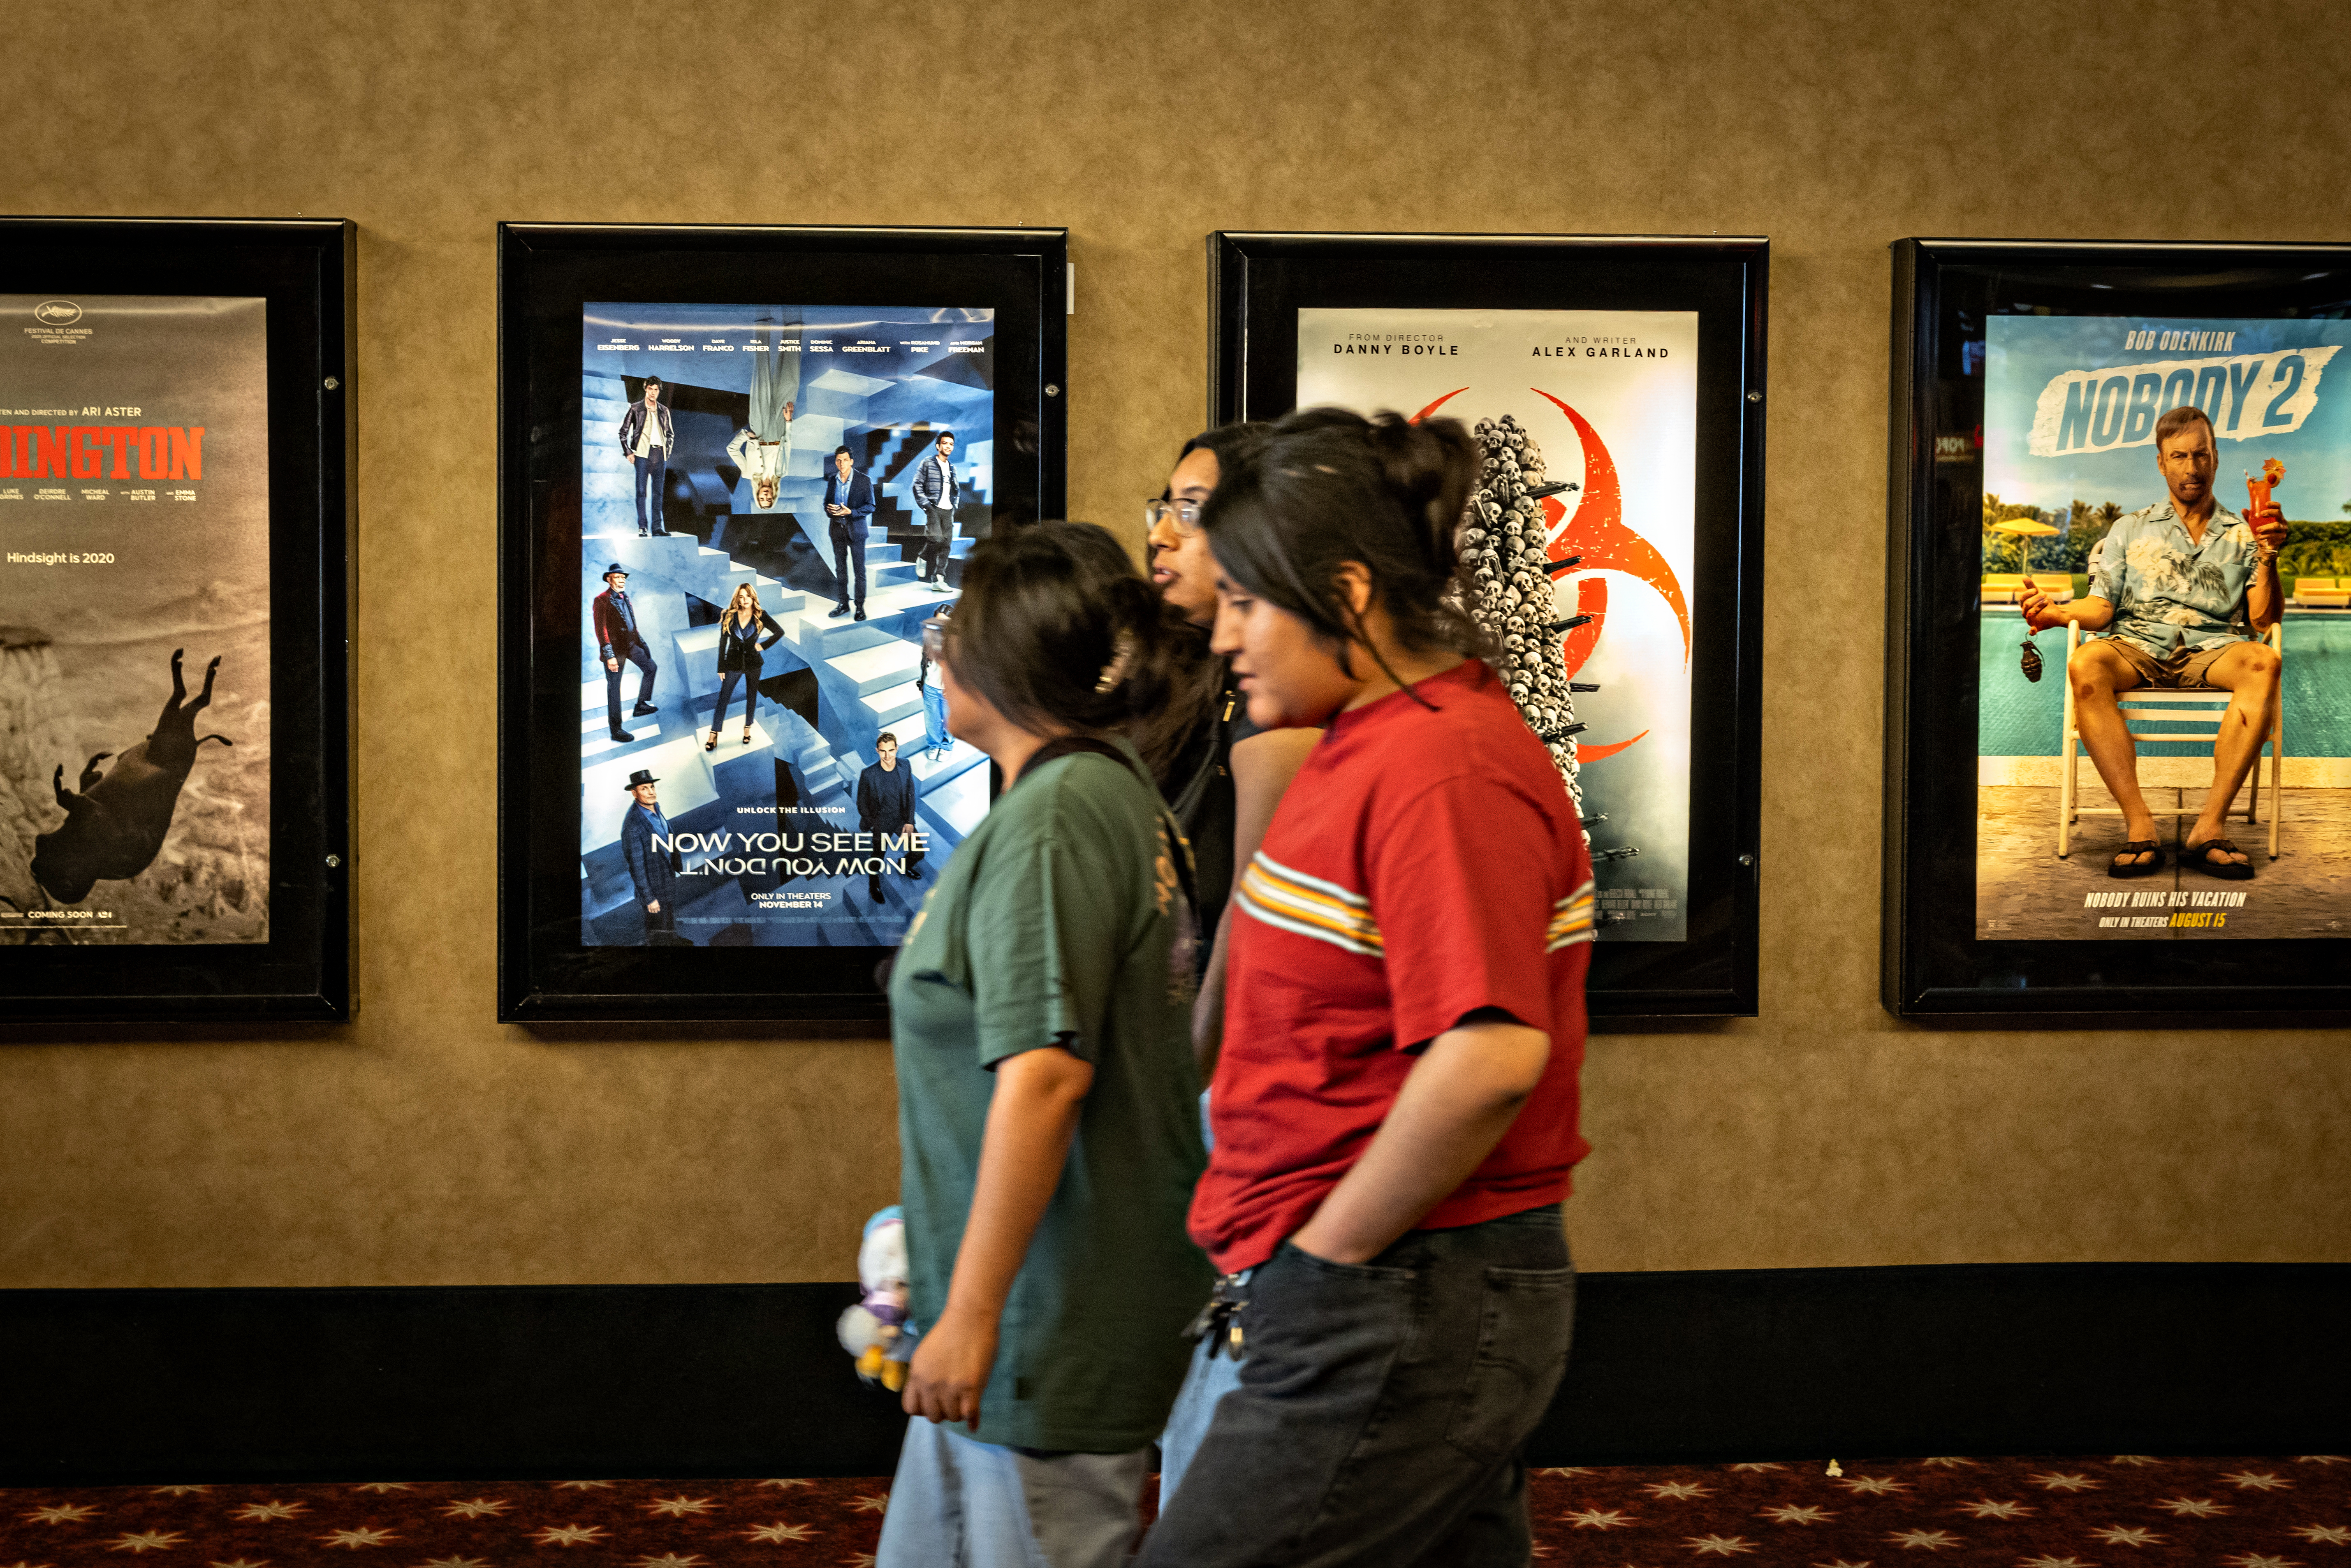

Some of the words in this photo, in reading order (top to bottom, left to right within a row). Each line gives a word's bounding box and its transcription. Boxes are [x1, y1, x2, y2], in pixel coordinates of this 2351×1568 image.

[2125, 330, 2155, 350] BOB
[2159, 331, 2236, 351] ODENKIRK
[1334, 345, 1392, 354] DANNY
[1402, 345, 1459, 355] BOYLE
[1532, 347, 1576, 357] ALEX
[1587, 347, 1669, 358] GARLAND
[2057, 360, 2263, 451] NOBODY
[2263, 355, 2305, 427] 2
[82, 407, 101, 416] ARI
[105, 407, 141, 417] ASTER
[7, 553, 66, 565] Hindsight
[69, 553, 80, 563] is
[82, 553, 115, 563] 2020
[651, 833, 732, 852] NOW
[738, 833, 804, 852] YOU
[811, 833, 872, 852] SEE
[881, 832, 930, 852] ME
[772, 858, 830, 875] YOU
[835, 858, 906, 875] NOW
[2084, 892, 2130, 908] NOBODY
[2131, 892, 2166, 907] RUINS
[2167, 892, 2188, 907] HIS
[2191, 892, 2246, 907] VACATION
[2098, 917, 2119, 927] ONLY
[2120, 917, 2129, 927] IN
[2130, 917, 2168, 927] THEATERS
[2168, 913, 2212, 927] AUGUST
[2213, 913, 2227, 927] 15
